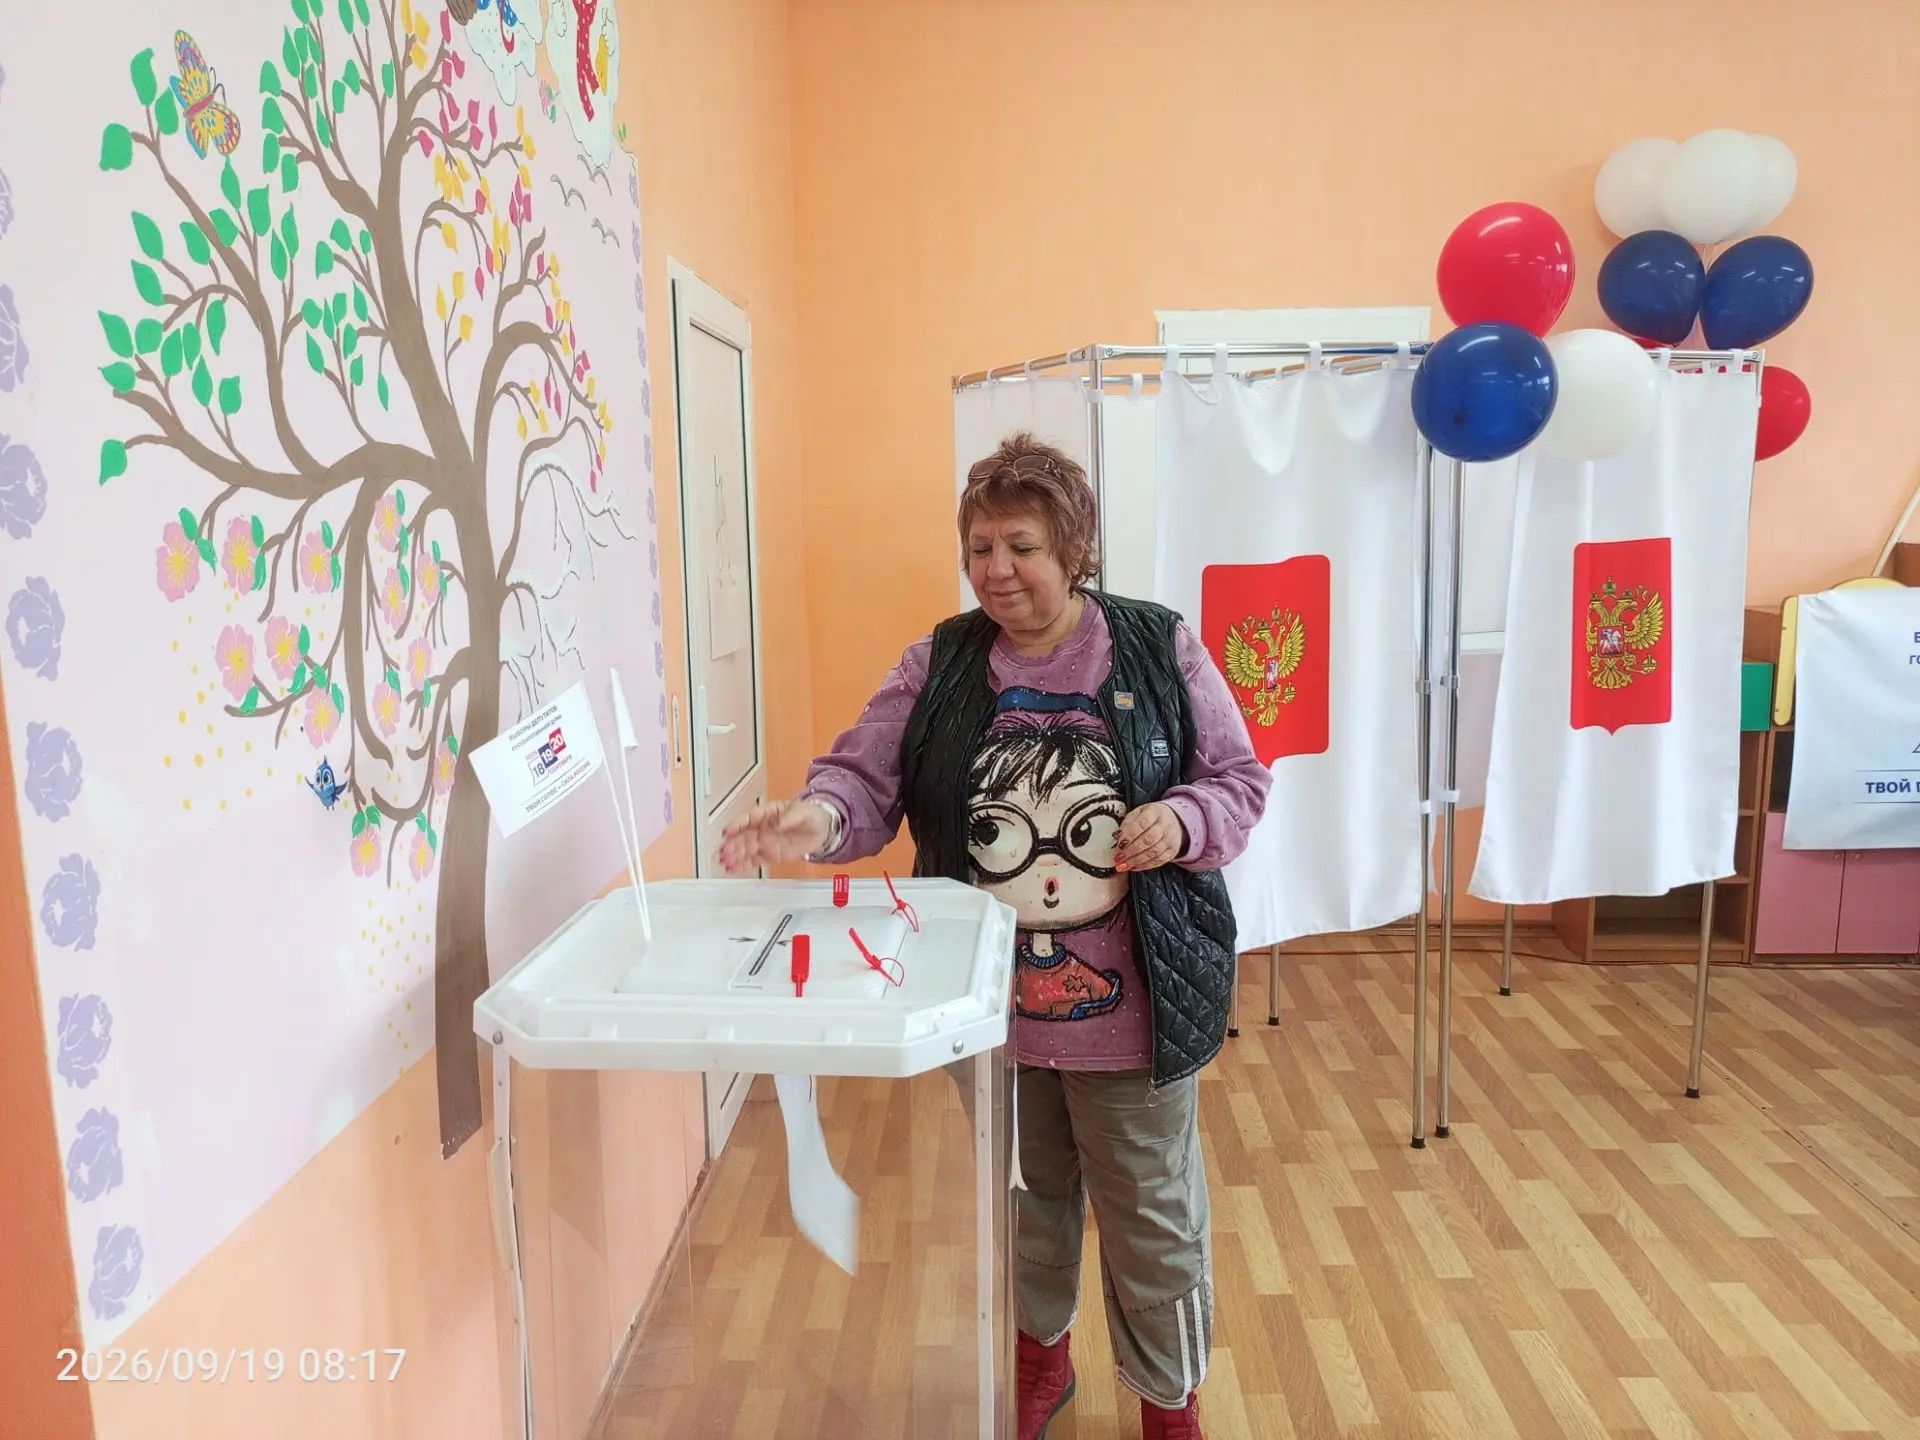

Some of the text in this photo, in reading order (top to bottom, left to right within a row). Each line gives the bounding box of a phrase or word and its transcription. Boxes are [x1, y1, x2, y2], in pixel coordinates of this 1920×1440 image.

[533, 733, 563, 777] 18 19 20
[1865, 778, 1911, 794] ТВОЙ
